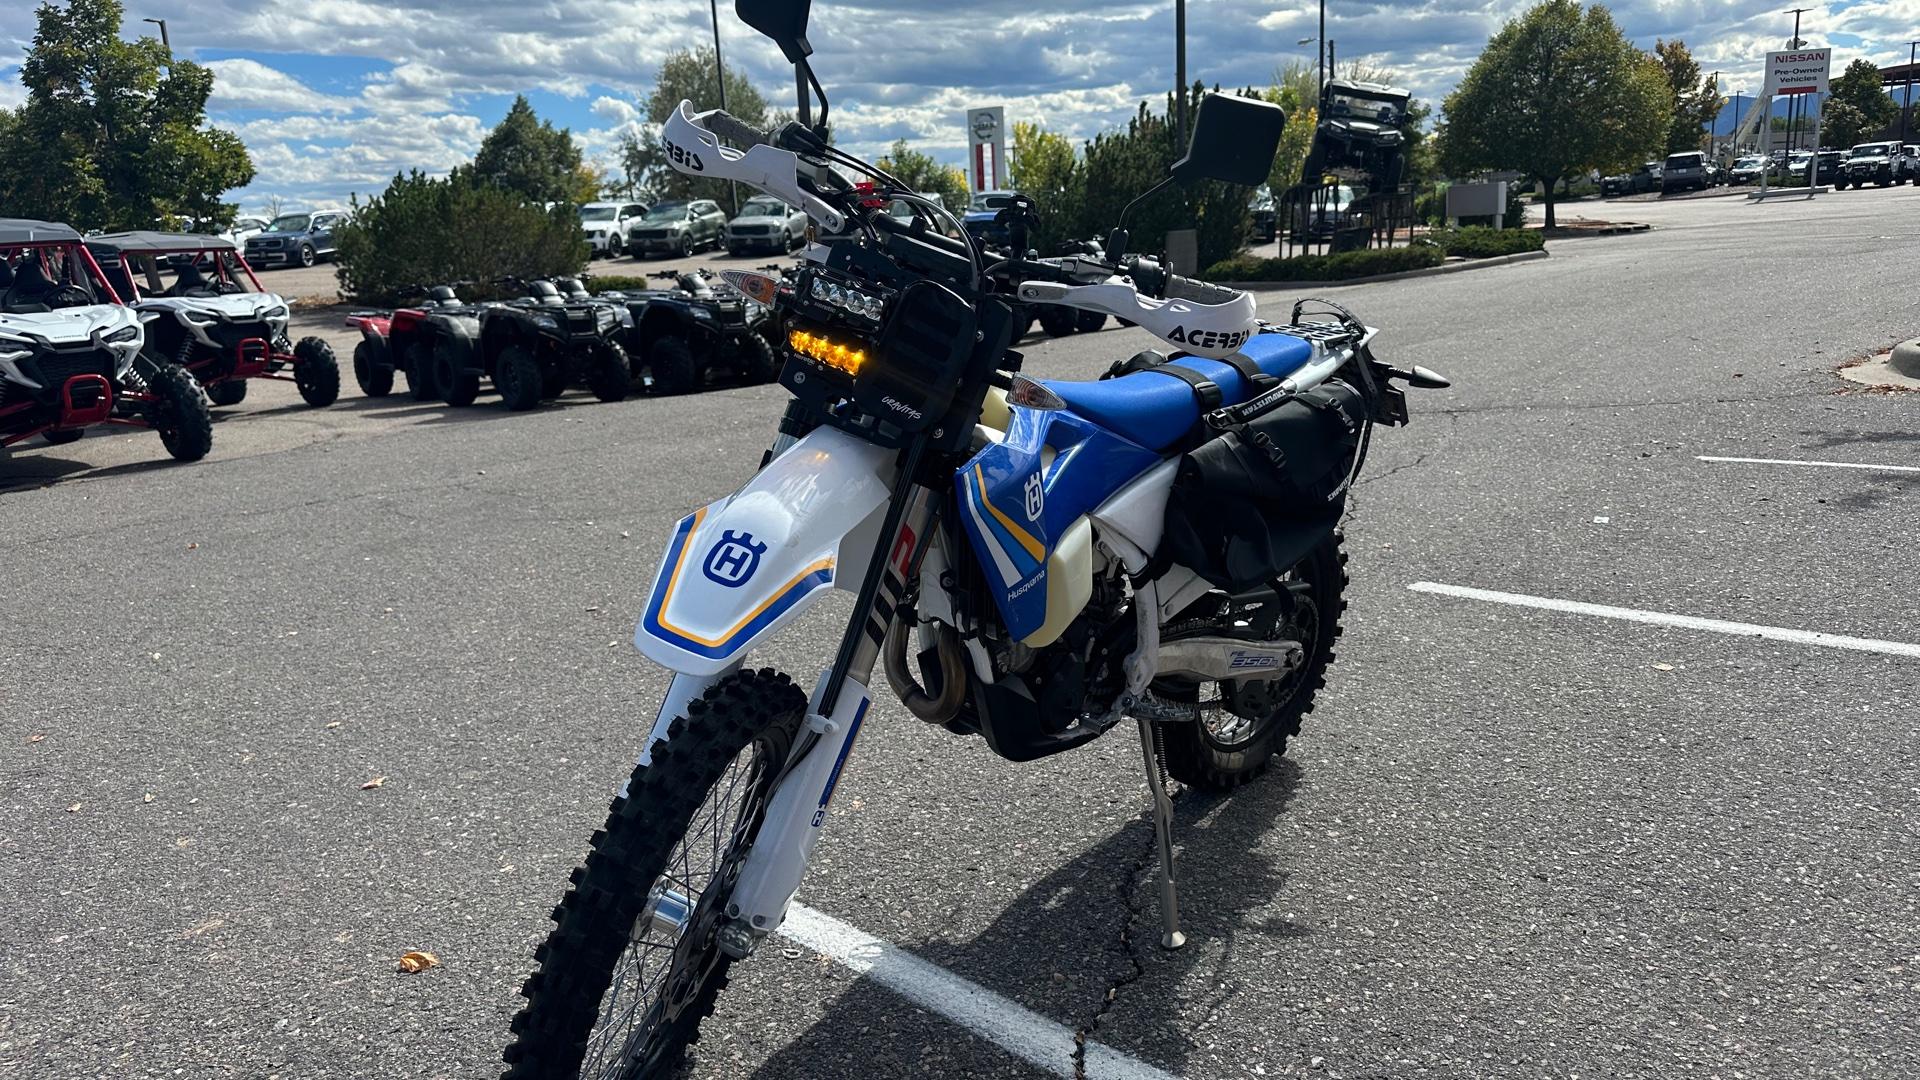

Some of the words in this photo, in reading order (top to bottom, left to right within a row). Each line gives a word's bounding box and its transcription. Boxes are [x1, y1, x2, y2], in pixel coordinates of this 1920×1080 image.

[1775, 52, 1825, 63] NISSAN
[1774, 66, 1824, 76] Pre-Owned
[1780, 75, 1817, 83] Vehicles
[881, 396, 922, 424] GRAVITAS
[1007, 569, 1046, 602] Husqvarna
